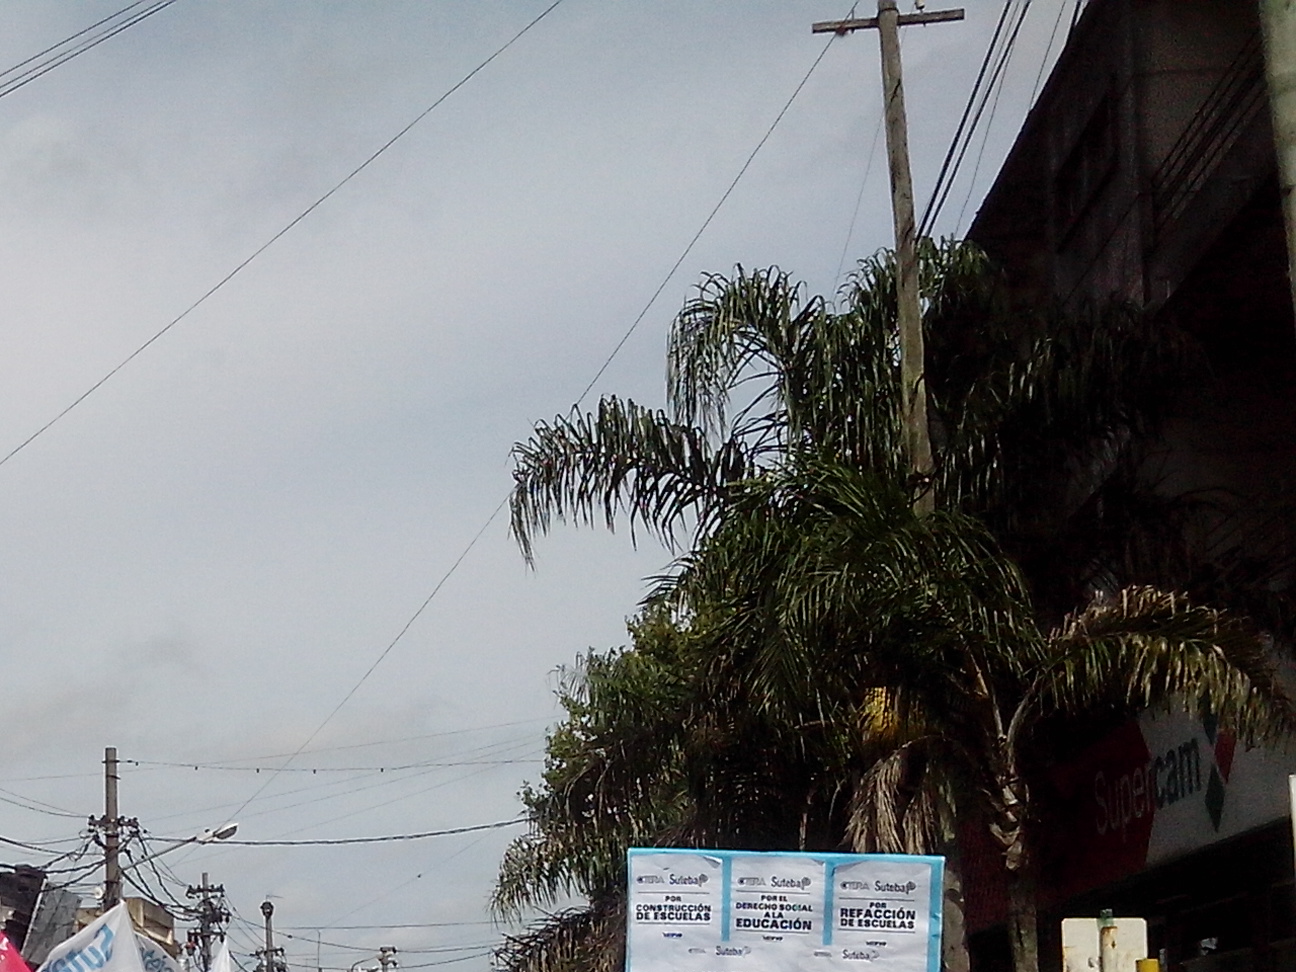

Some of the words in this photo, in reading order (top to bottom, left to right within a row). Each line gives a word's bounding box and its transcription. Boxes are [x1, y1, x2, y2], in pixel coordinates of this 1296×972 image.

[1095, 738, 1202, 841] Supercam
[771, 876, 801, 888] Suteba
[874, 880, 906, 892] Suteba
[636, 903, 711, 912] CONSTRUCCIÓN
[736, 902, 777, 910] DERECHO
[779, 904, 813, 912] SOCIAL
[636, 912, 650, 920] DE
[654, 912, 711, 921] ESCUELAS
[840, 907, 916, 920] REFACCIÓN
[736, 917, 812, 930] EDUCACIÓN
[840, 918, 854, 927] DE
[858, 919, 914, 929] ESCUELAS
